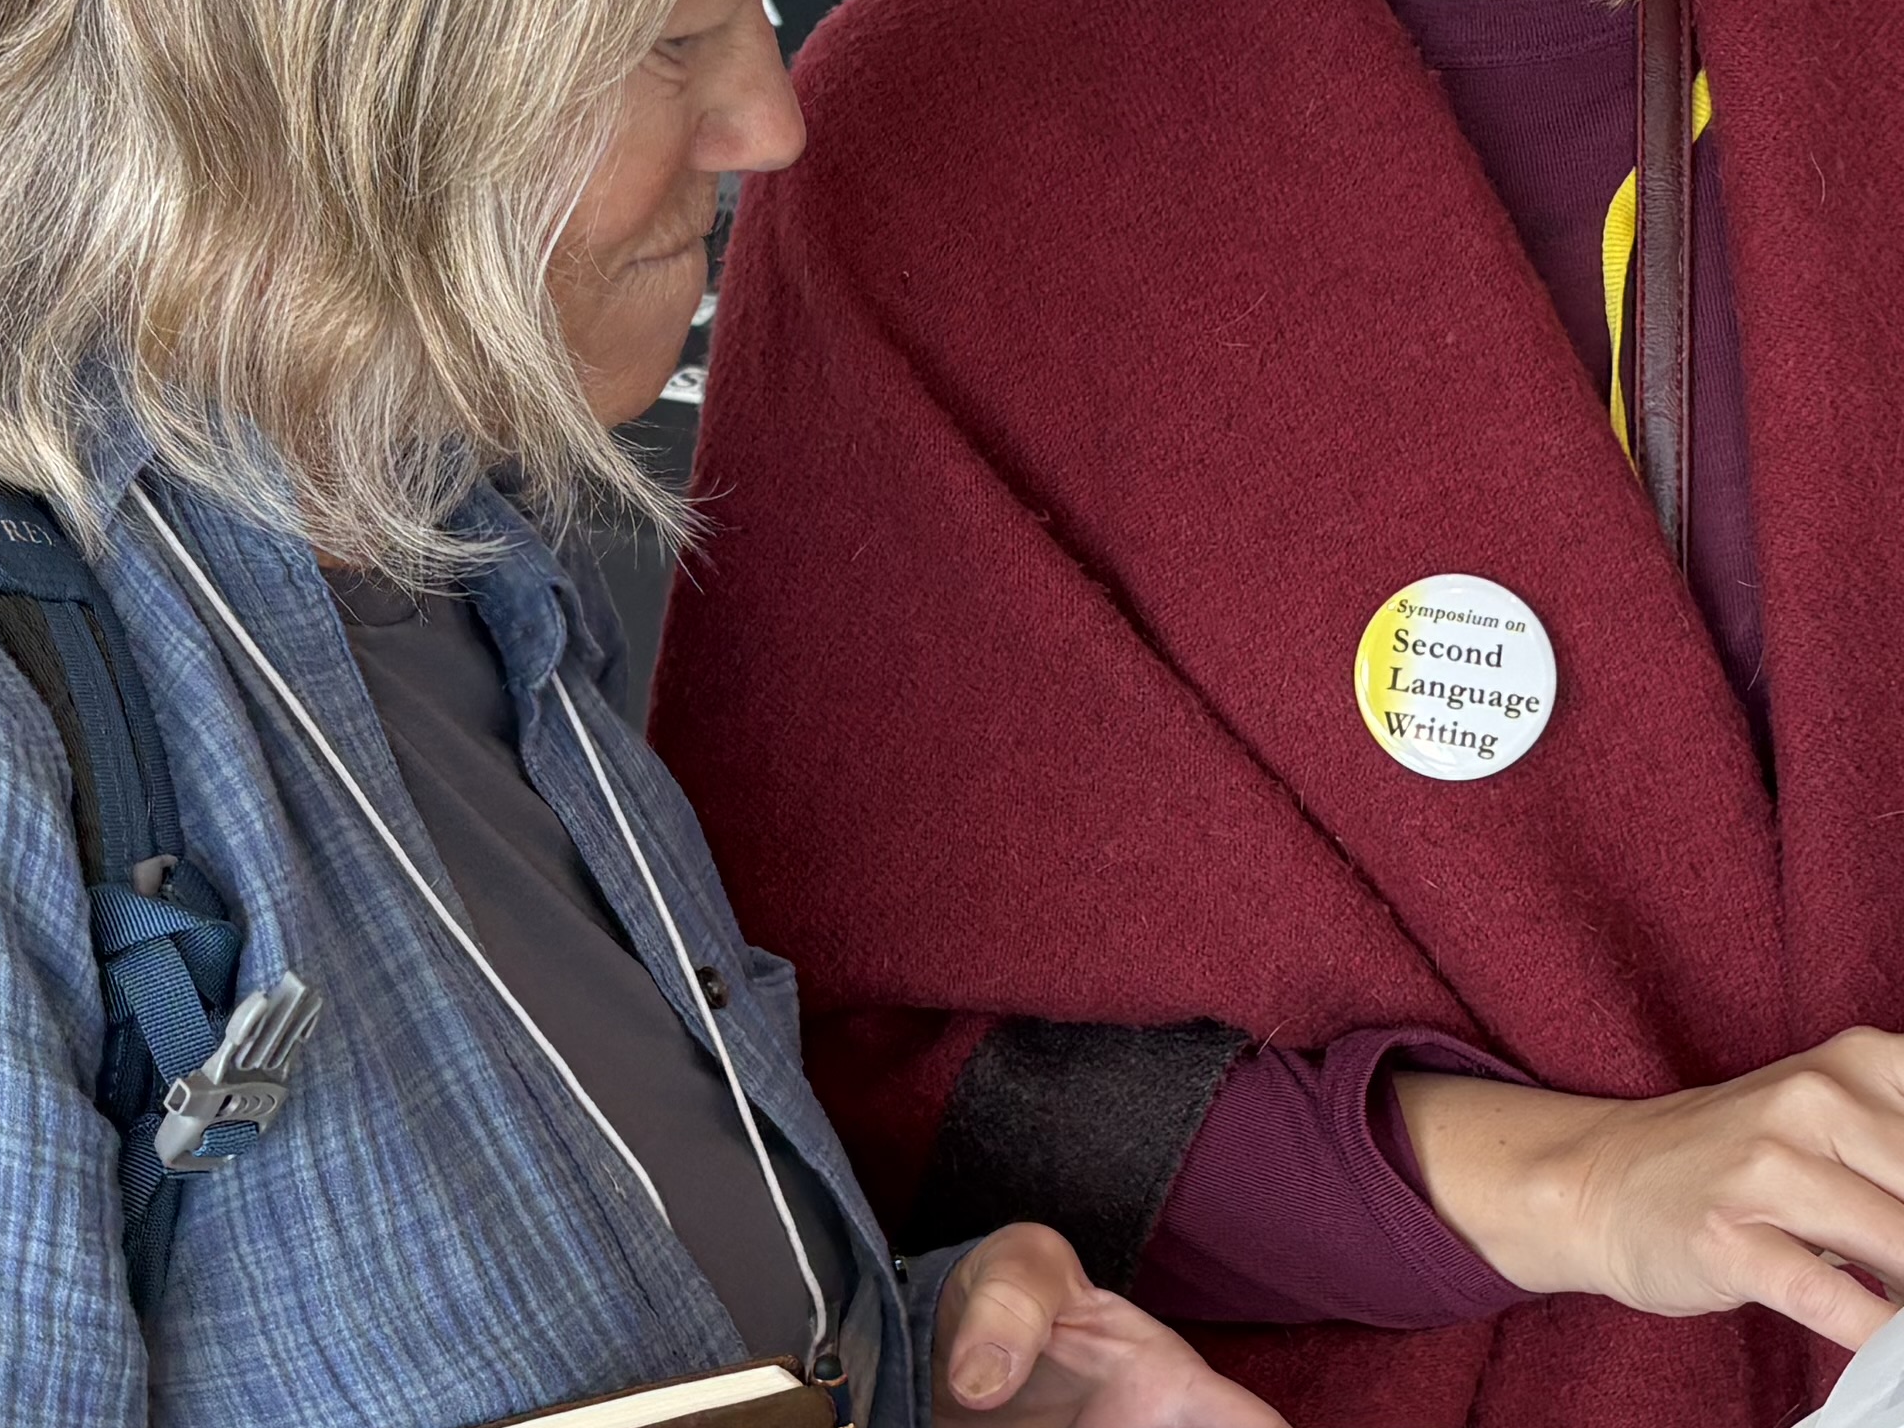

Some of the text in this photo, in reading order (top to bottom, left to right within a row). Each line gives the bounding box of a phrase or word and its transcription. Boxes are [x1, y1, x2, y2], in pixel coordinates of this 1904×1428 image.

[1396, 598, 1527, 633] Symposium on
[1392, 628, 1505, 668] Second
[1387, 666, 1541, 719] Language
[1384, 711, 1499, 760] Writing
